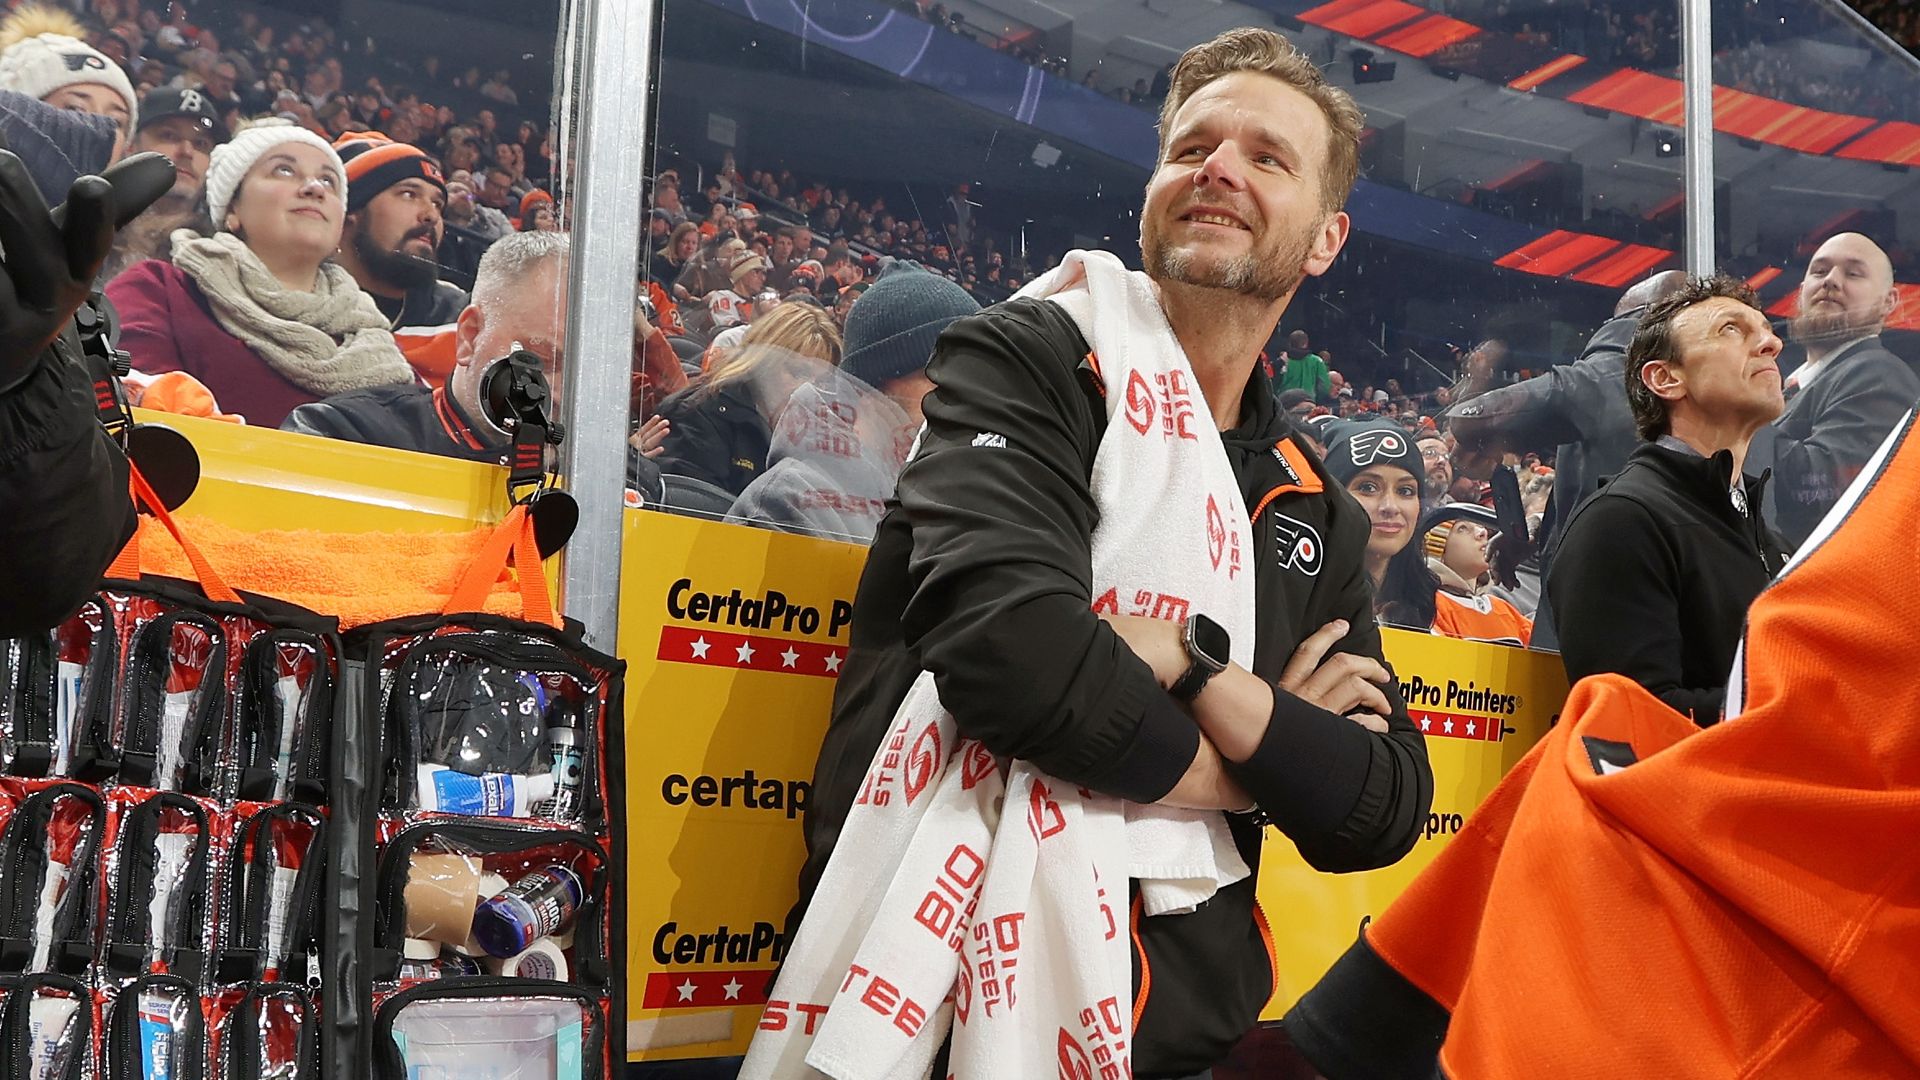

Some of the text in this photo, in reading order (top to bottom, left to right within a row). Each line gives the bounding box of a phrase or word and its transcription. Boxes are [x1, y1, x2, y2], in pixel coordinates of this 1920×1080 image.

[667, 578, 821, 635] CertaPro
[873, 718, 911, 807] STEEL
[914, 842, 985, 940] BIO
[973, 921, 1001, 1019] STEEL
